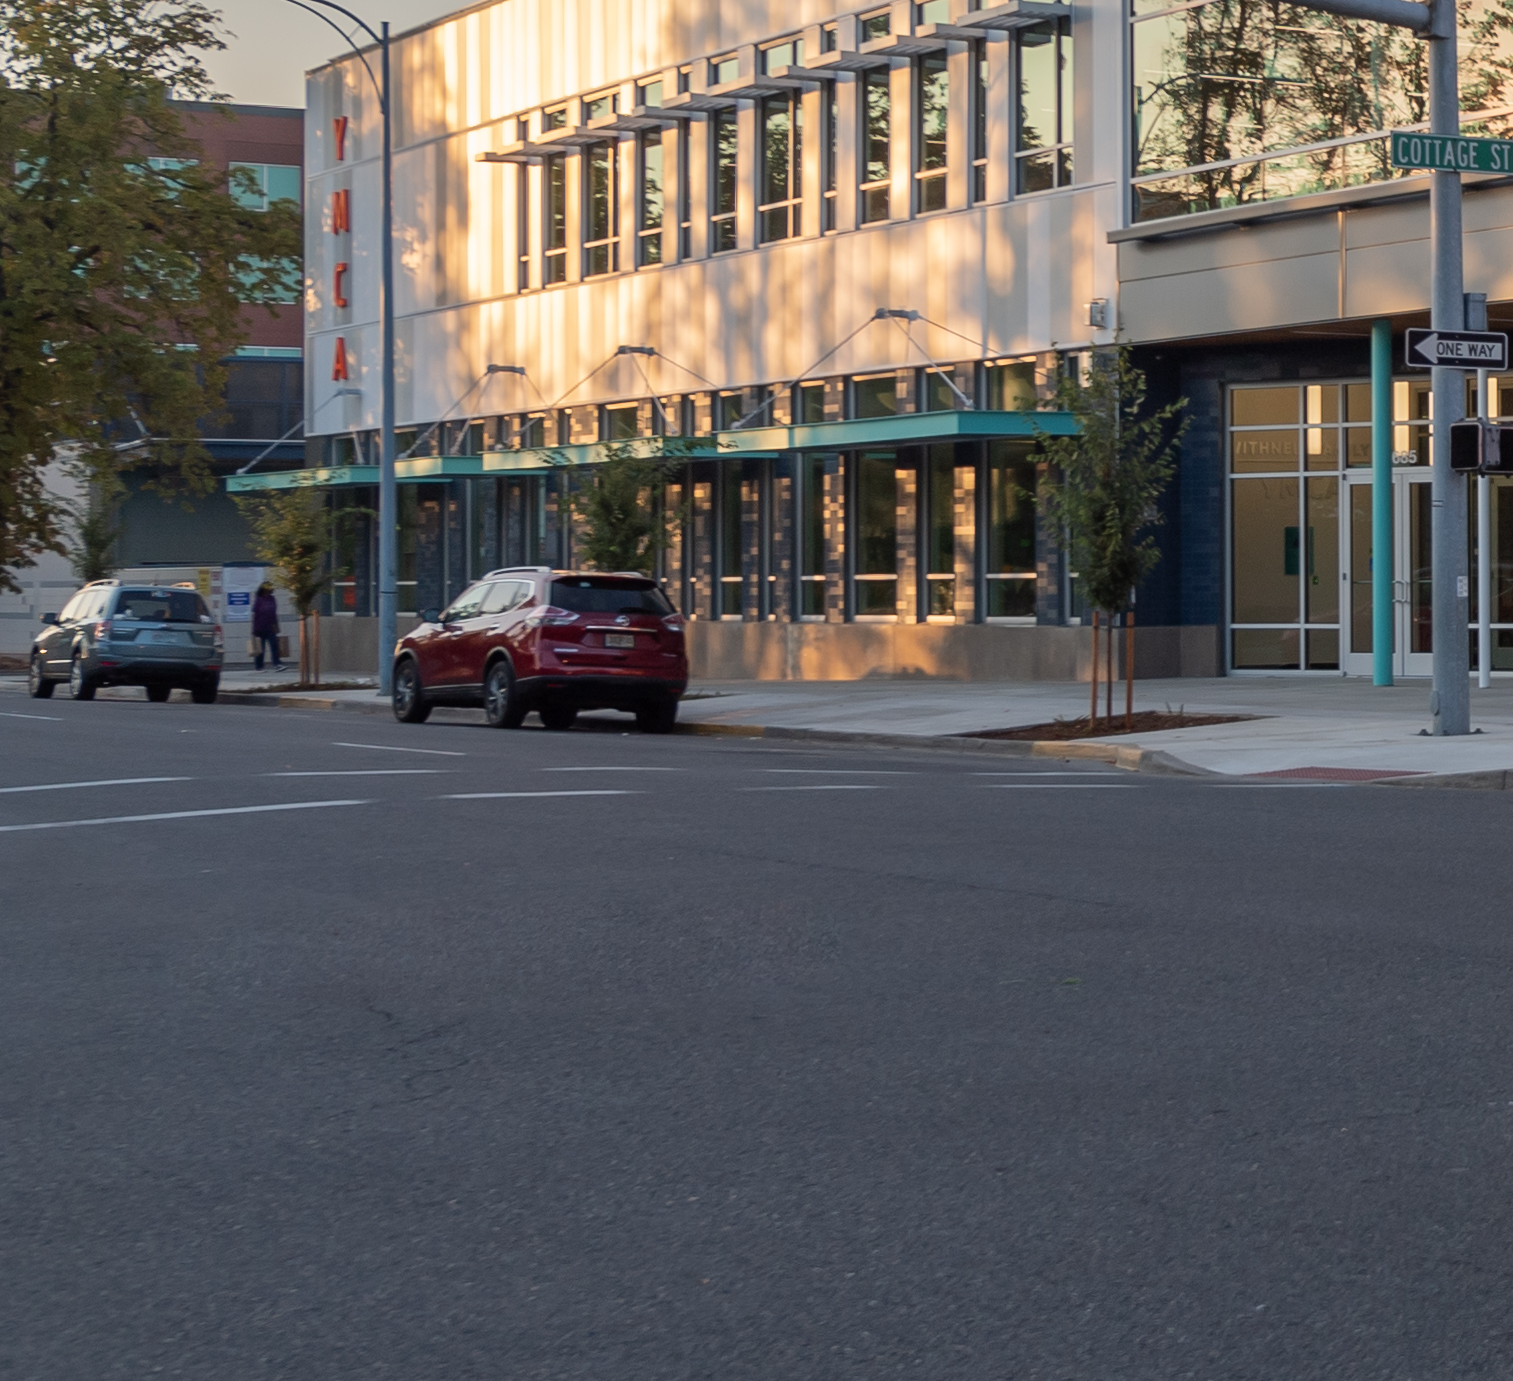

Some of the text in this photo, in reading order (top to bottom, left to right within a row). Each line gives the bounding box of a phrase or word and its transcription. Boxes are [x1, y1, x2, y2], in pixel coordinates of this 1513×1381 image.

[1398, 137, 1511, 171] COTTAGE ST
[331, 115, 350, 382] YMCA
[1437, 341, 1496, 358] ONE WAY
[1391, 450, 1418, 464] 685
